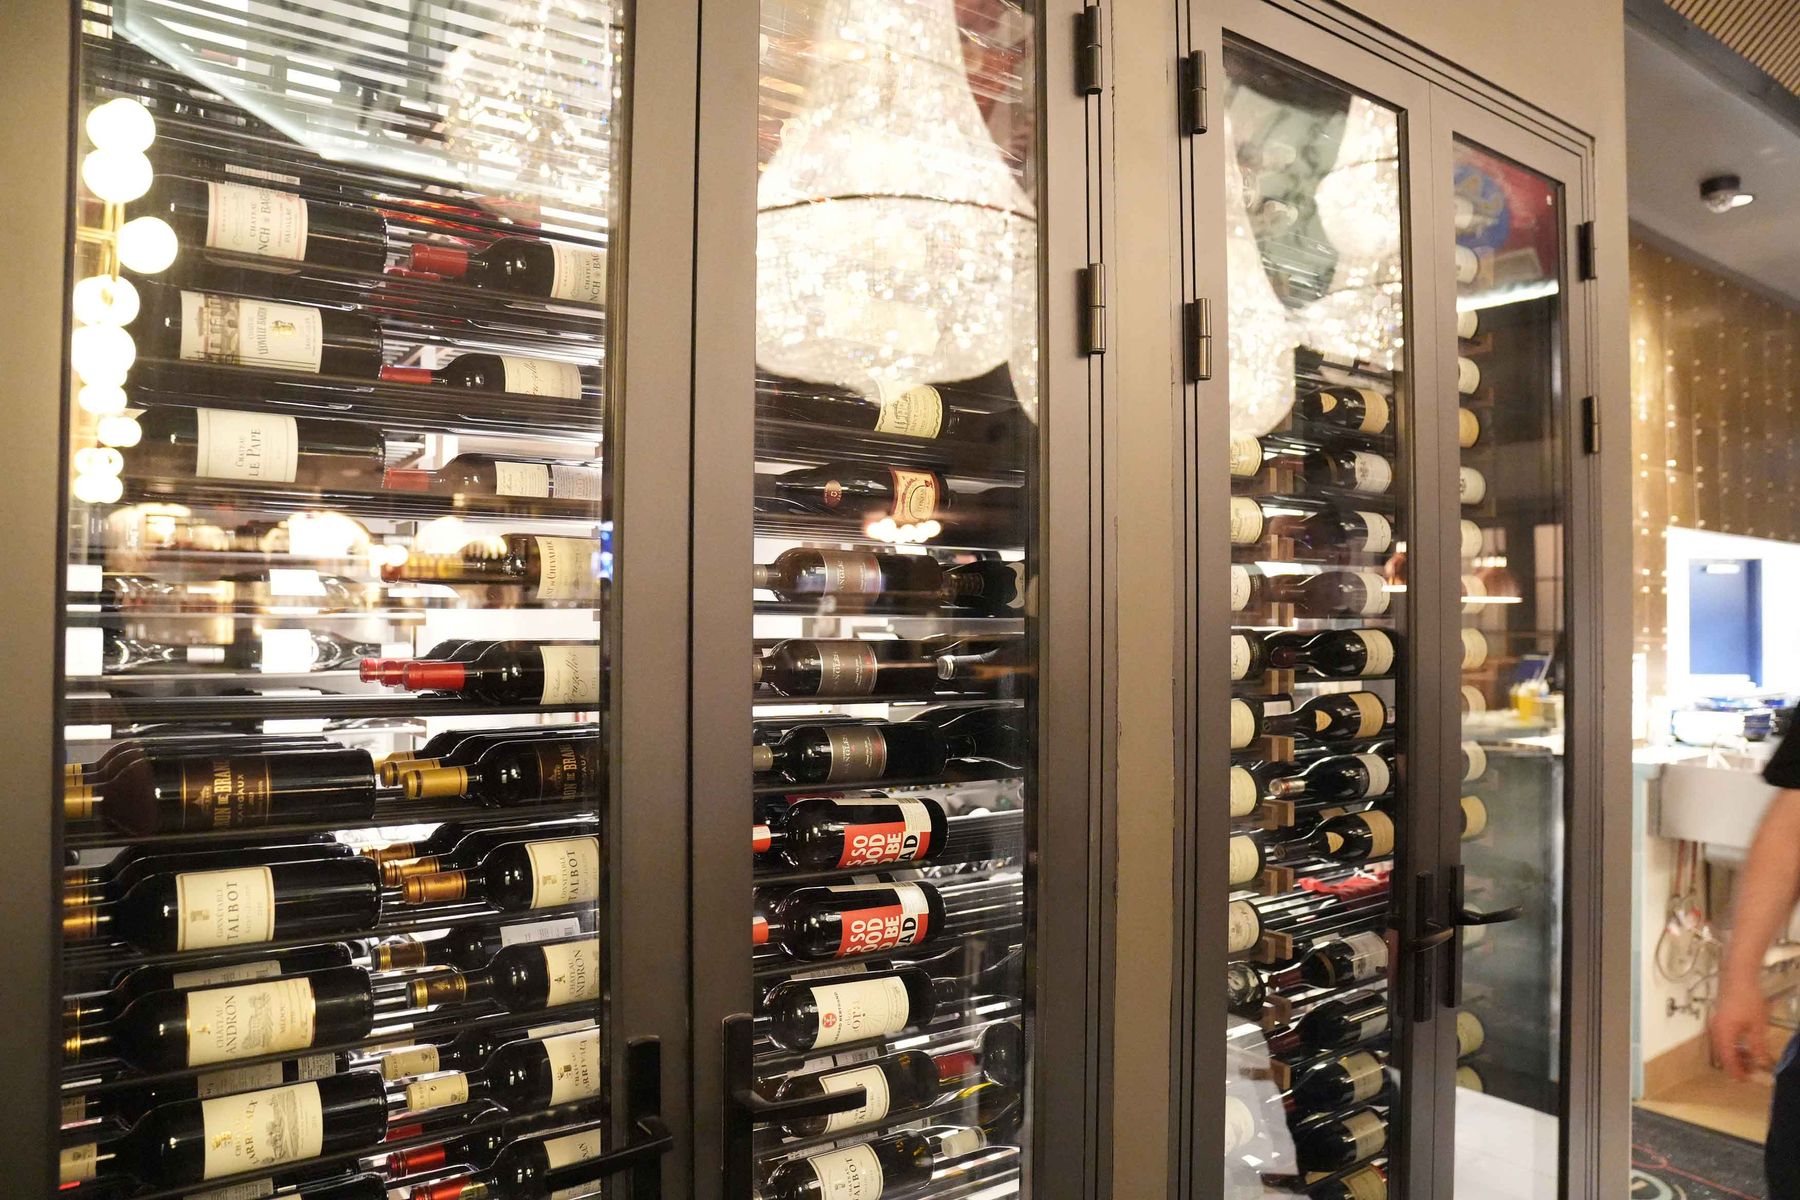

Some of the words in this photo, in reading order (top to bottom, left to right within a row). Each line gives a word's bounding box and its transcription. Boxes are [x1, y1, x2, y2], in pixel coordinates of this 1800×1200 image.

[257, 227, 272, 254] NCH
[590, 281, 601, 302] NCH
[246, 428, 262, 457] PAPE
[249, 462, 261, 477] LE
[850, 835, 869, 857] SO
[884, 832, 902, 855] BE
[899, 835, 918, 860] AD
[566, 848, 580, 901] TALBOT
[226, 881, 240, 941] TALBOT
[850, 920, 867, 943] SO
[860, 918, 884, 953] OOD
[883, 915, 900, 939] BE
[898, 917, 917, 944] AD
[224, 994, 238, 1055] ANDRON
[845, 1158, 861, 1200] ALBOT
